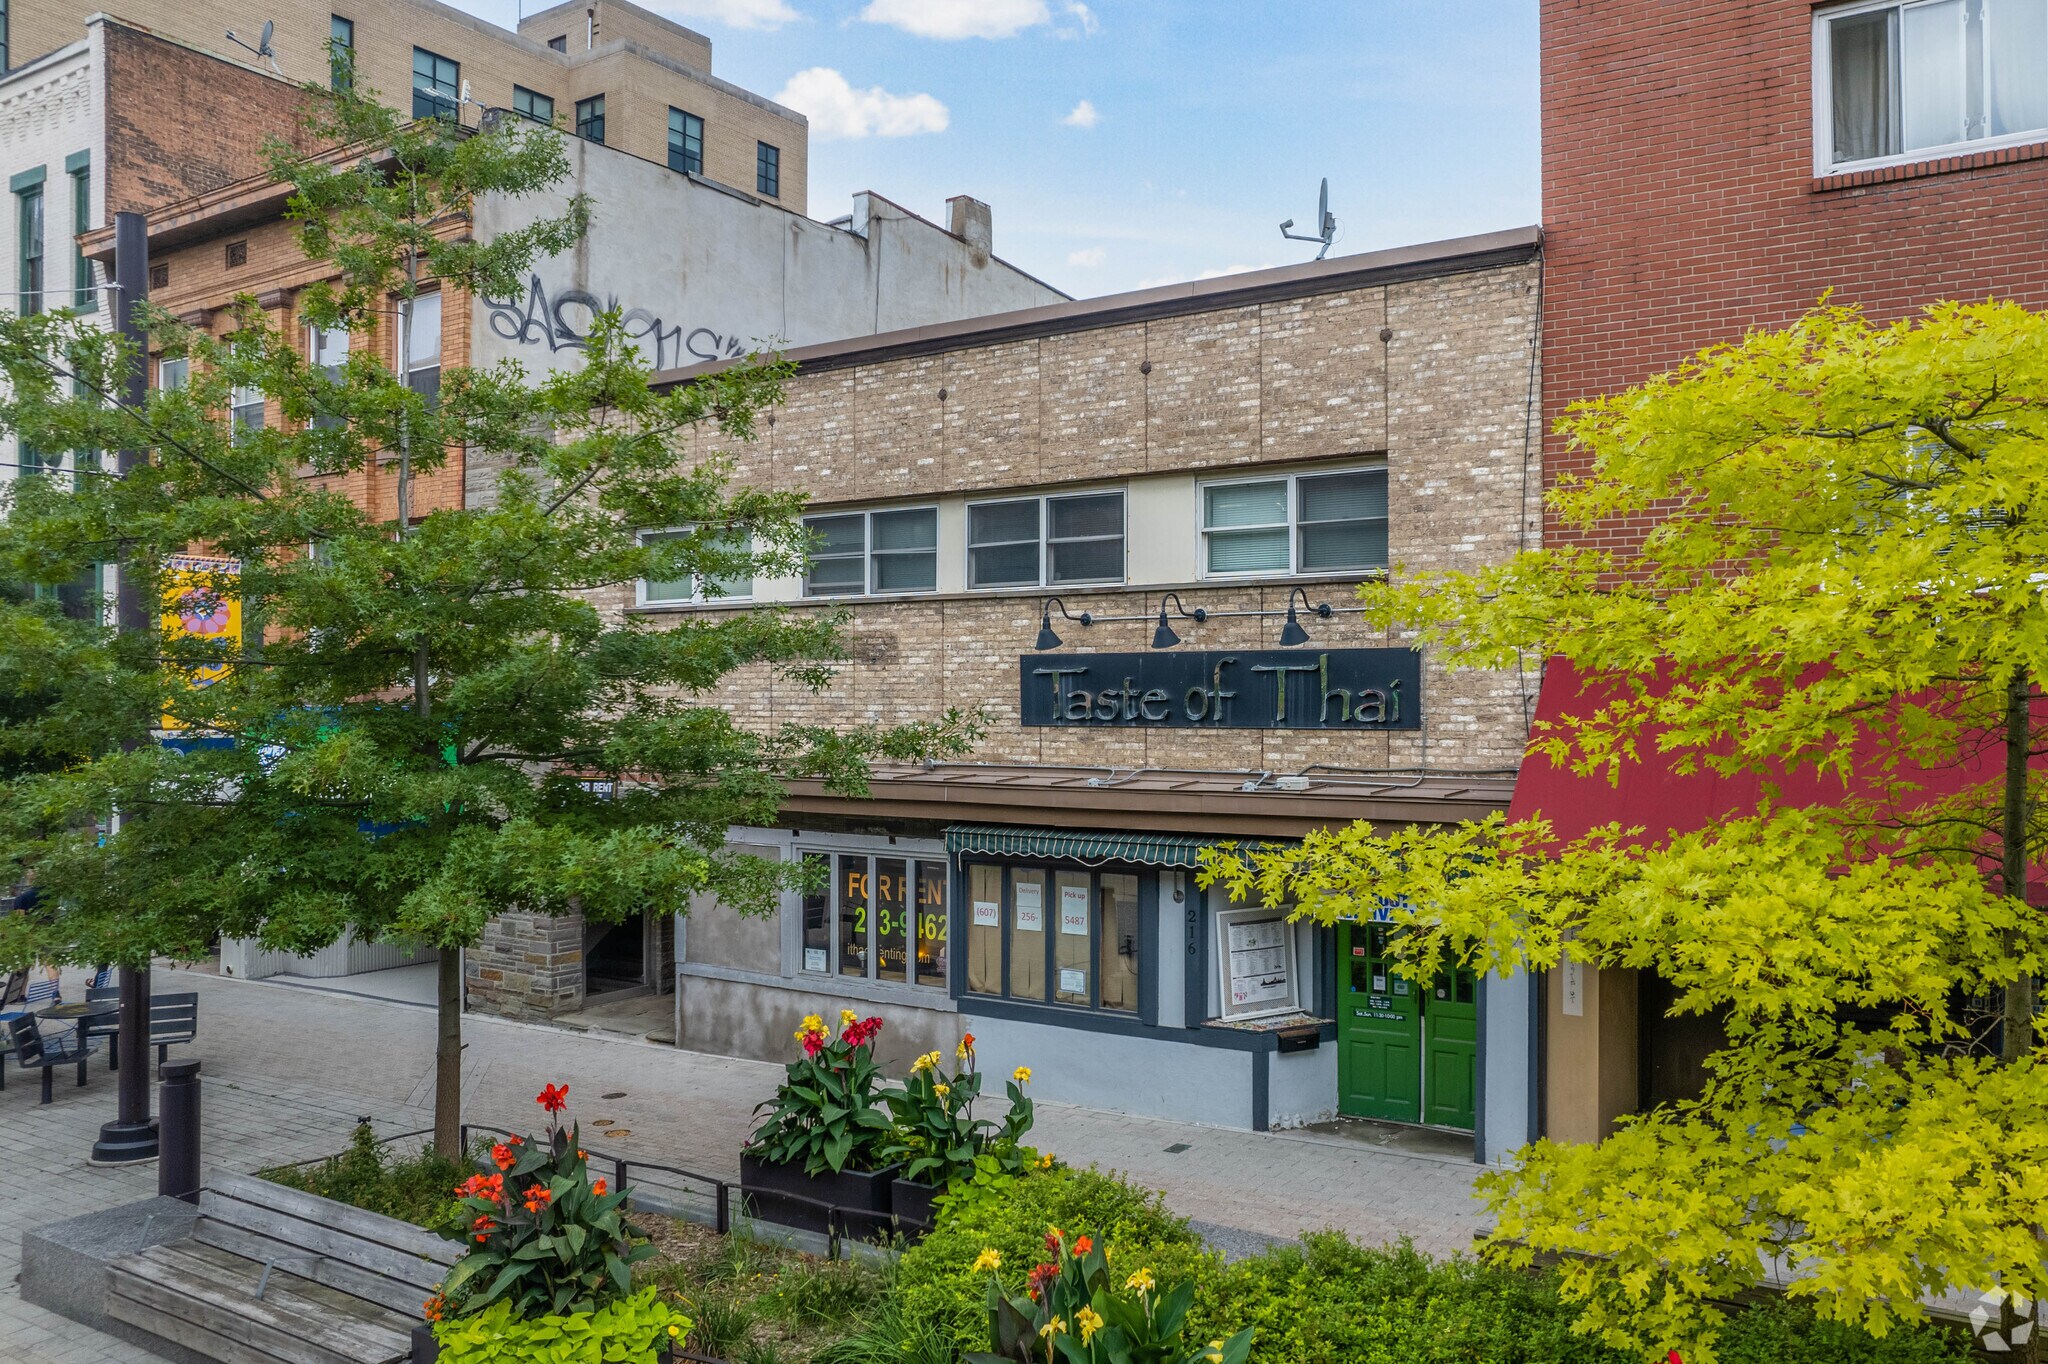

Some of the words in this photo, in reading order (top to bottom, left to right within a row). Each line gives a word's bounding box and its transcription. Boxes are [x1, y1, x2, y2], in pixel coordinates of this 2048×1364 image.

[1032, 666, 1170, 721] Taste
[1183, 655, 1237, 722] of
[1250, 652, 1401, 723] Thai
[593, 782, 613, 792] RENT
[898, 876, 947, 905] REN
[1018, 887, 1040, 895] Delivery
[1064, 891, 1077, 899] Pick
[976, 907, 996, 919] (607)
[1021, 912, 1038, 922] 256-
[854, 906, 947, 941] 23-9462
[1064, 915, 1085, 926] 5487
[1187, 910, 1197, 955] 216
